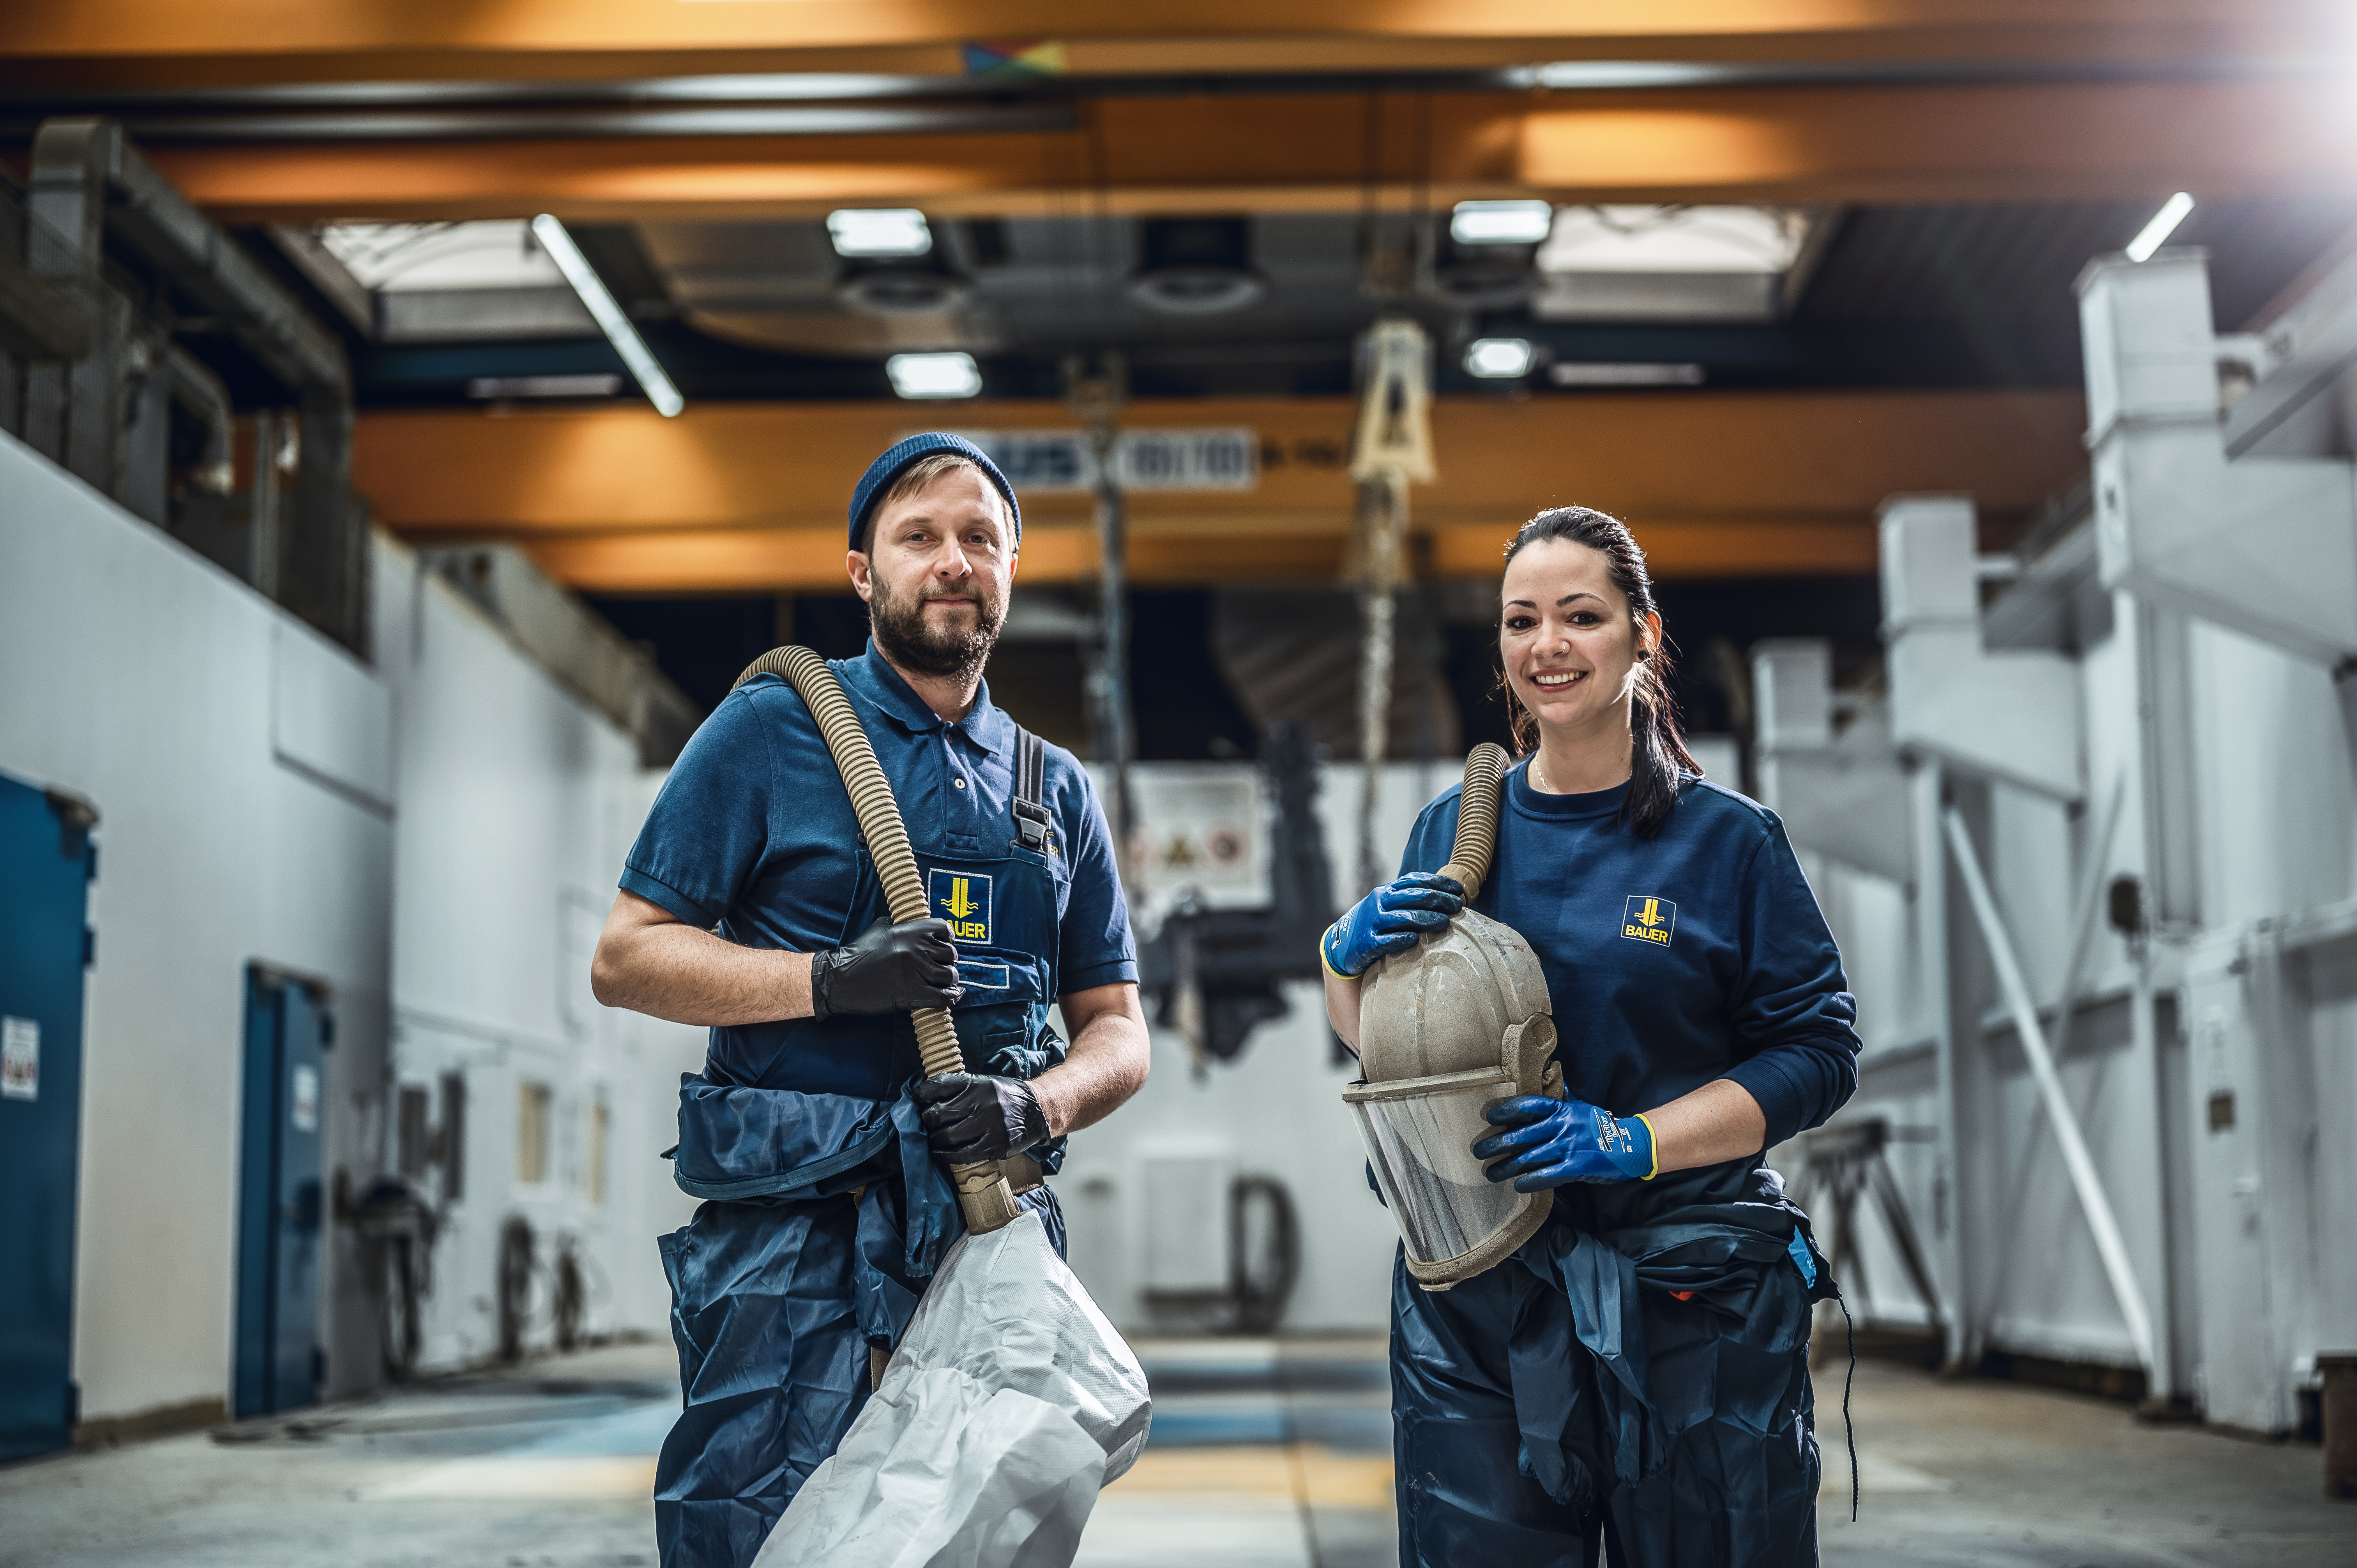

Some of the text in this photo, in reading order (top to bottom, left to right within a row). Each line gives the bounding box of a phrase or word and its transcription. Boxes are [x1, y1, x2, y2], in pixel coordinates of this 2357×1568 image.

[947, 920, 986, 938] UER
[1626, 925, 1668, 943] BAUER
[1603, 1118, 1614, 1142] HyFlex
